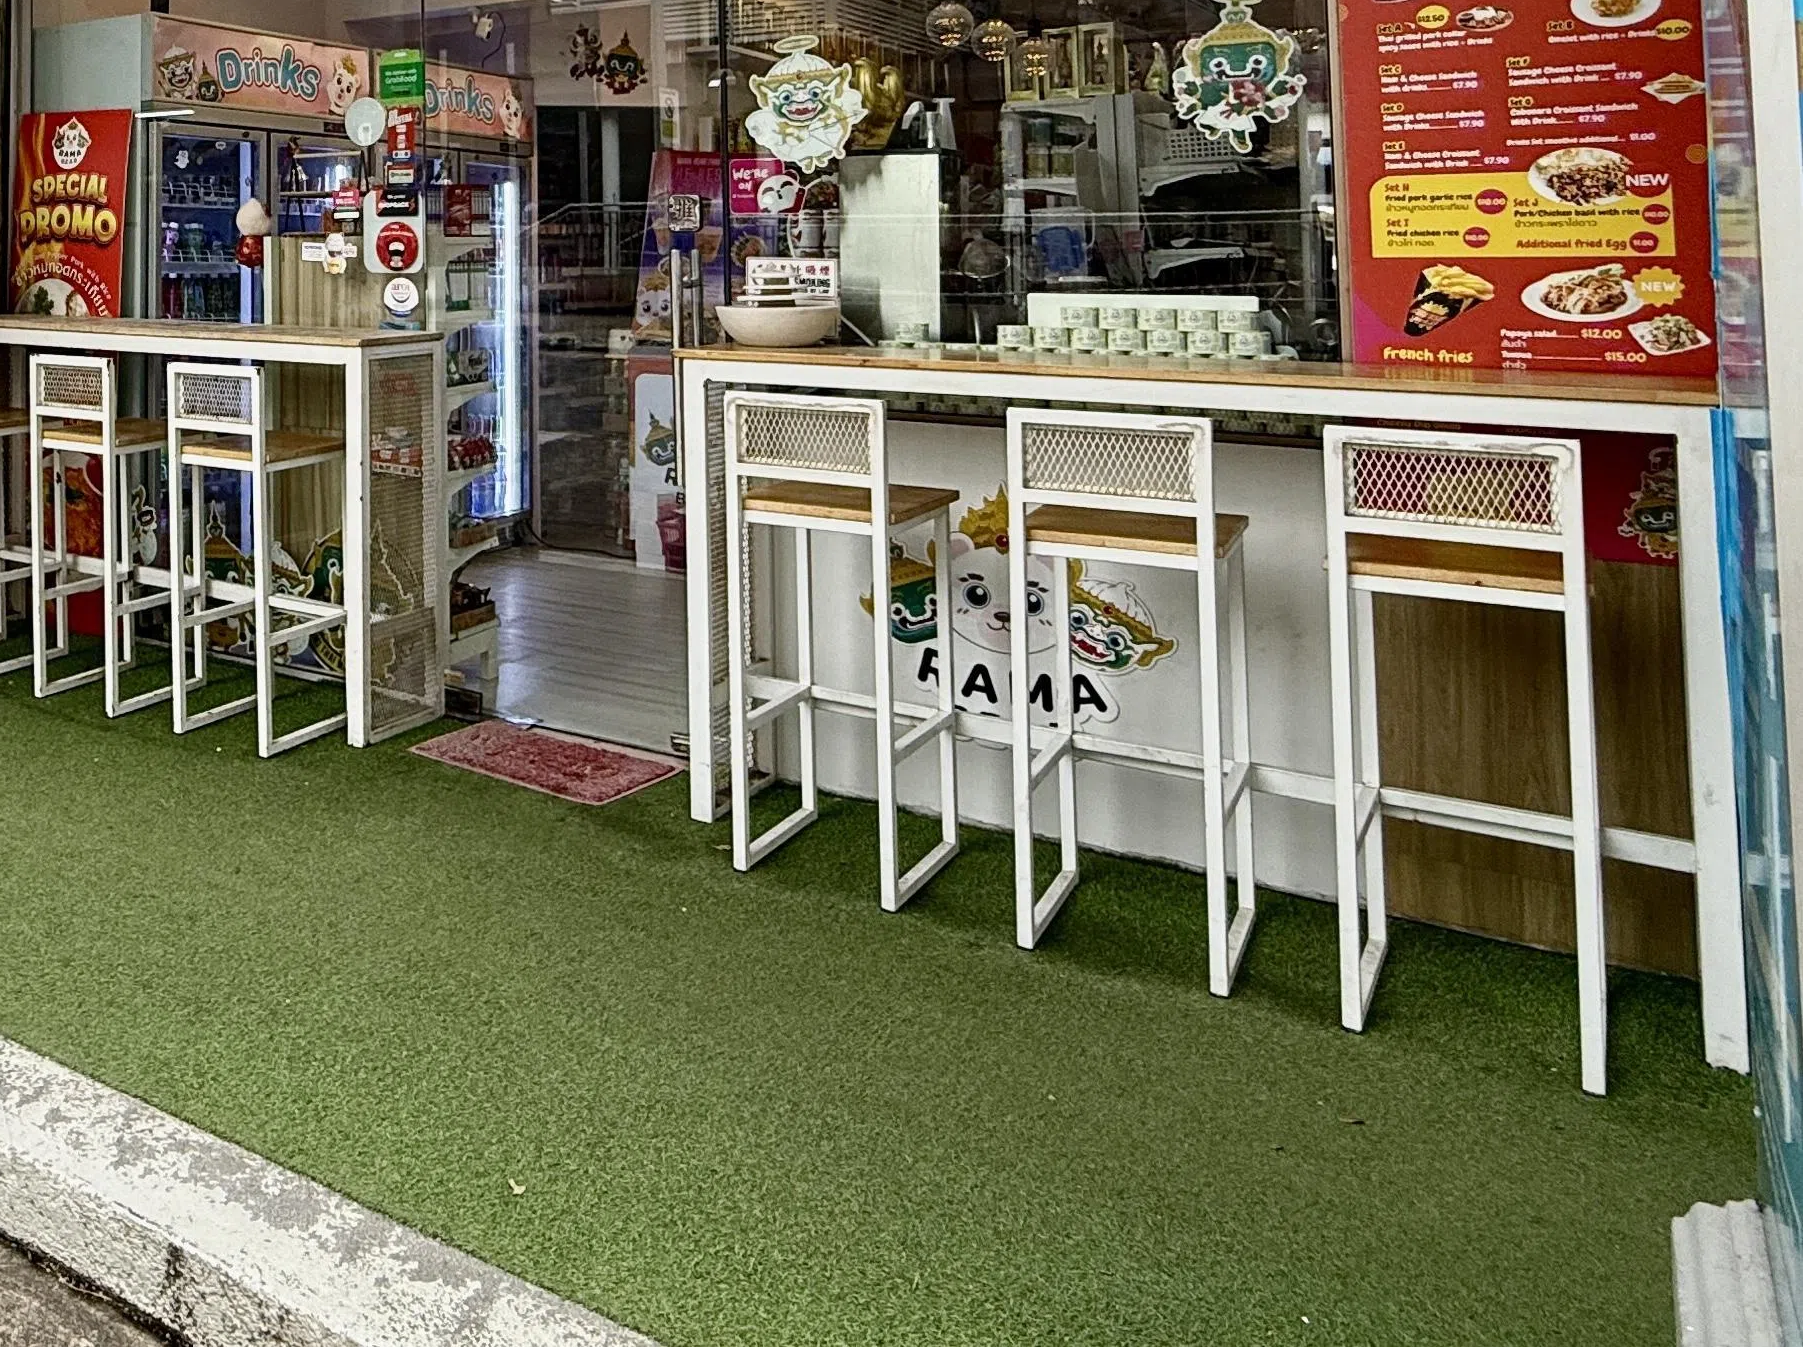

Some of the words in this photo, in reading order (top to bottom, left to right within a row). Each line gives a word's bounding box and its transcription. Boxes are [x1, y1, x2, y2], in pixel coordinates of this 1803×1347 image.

[1418, 14, 1445, 23] $12.50
[1378, 24, 1393, 33] Set
[1548, 22, 1563, 30] Set
[1656, 26, 1689, 35] $10.00
[217, 45, 319, 100] Drinks
[1614, 71, 1642, 81] $7.90
[1452, 80, 1478, 89] $7.90
[425, 75, 495, 124] Drinks
[1578, 114, 1605, 123] $7.90
[1459, 119, 1485, 128] $7.90
[1484, 156, 1509, 165] $7.90
[1625, 173, 1670, 187] NEW
[33, 173, 108, 203] SPECIAL
[1384, 183, 1400, 192] Set
[1408, 194, 1427, 203] pork
[1430, 194, 1454, 203] garlic
[1513, 198, 1529, 207] Set
[20, 204, 117, 243] PROMO
[1386, 219, 1401, 227] Set
[1516, 239, 1571, 249] Additional
[1605, 240, 1627, 251] Egg
[1641, 280, 1677, 293] NEW
[1581, 329, 1623, 339] $12.00
[1604, 352, 1647, 362] $15.00
